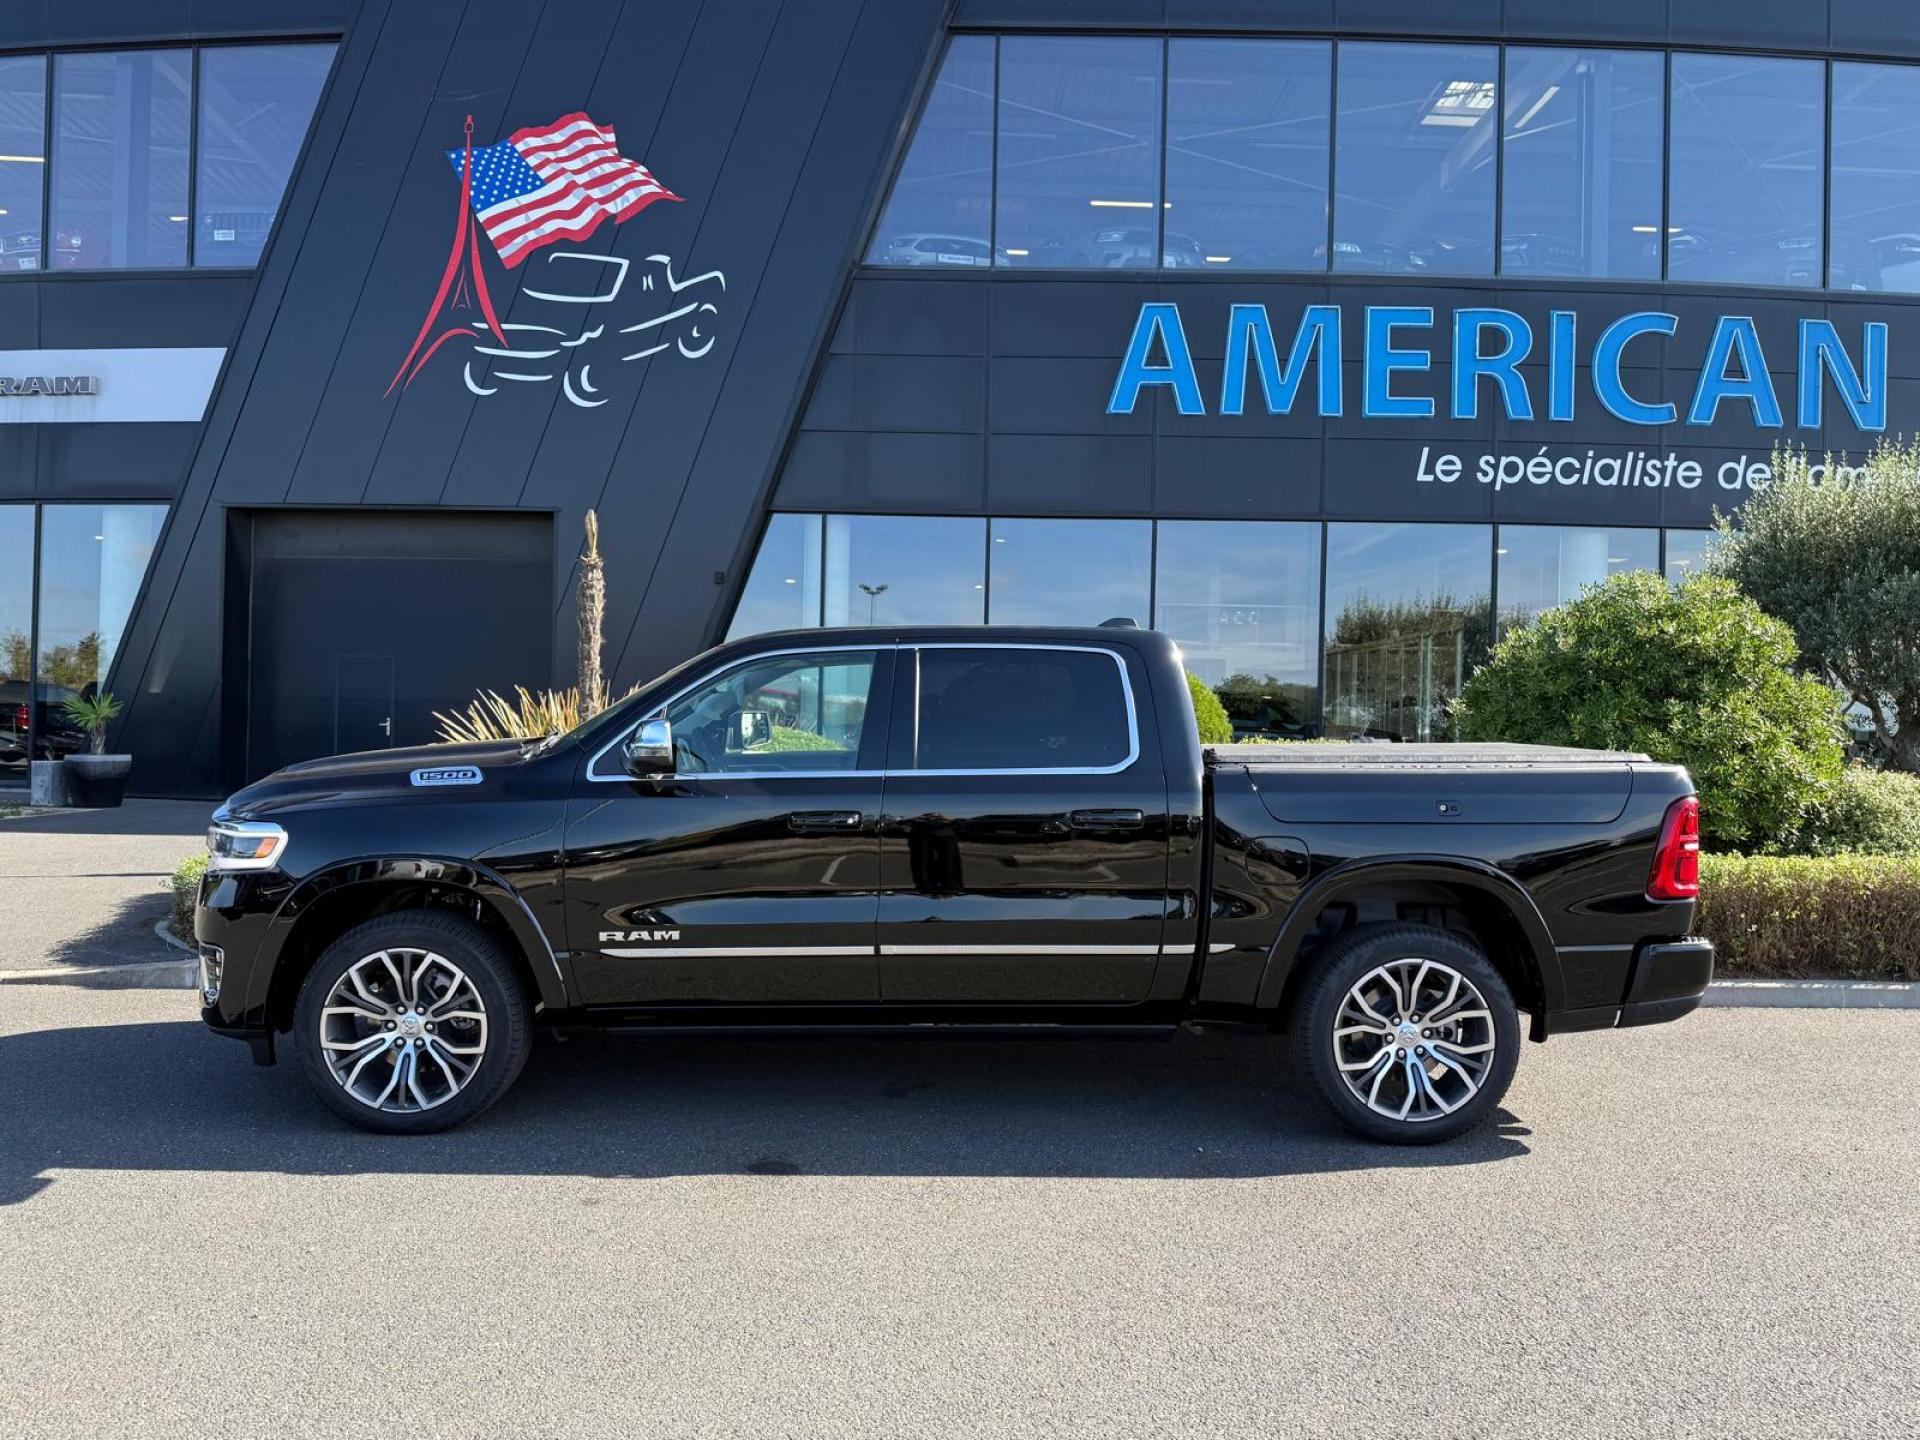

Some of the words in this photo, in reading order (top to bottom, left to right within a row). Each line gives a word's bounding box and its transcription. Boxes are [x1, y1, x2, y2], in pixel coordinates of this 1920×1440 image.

[1106, 303, 1888, 431] AMERICAN
[1416, 447, 1462, 483] Le
[1476, 446, 1703, 490] spécialiste
[1717, 455, 1772, 490] de
[421, 770, 474, 781] 1500
[598, 930, 681, 942] RAM
